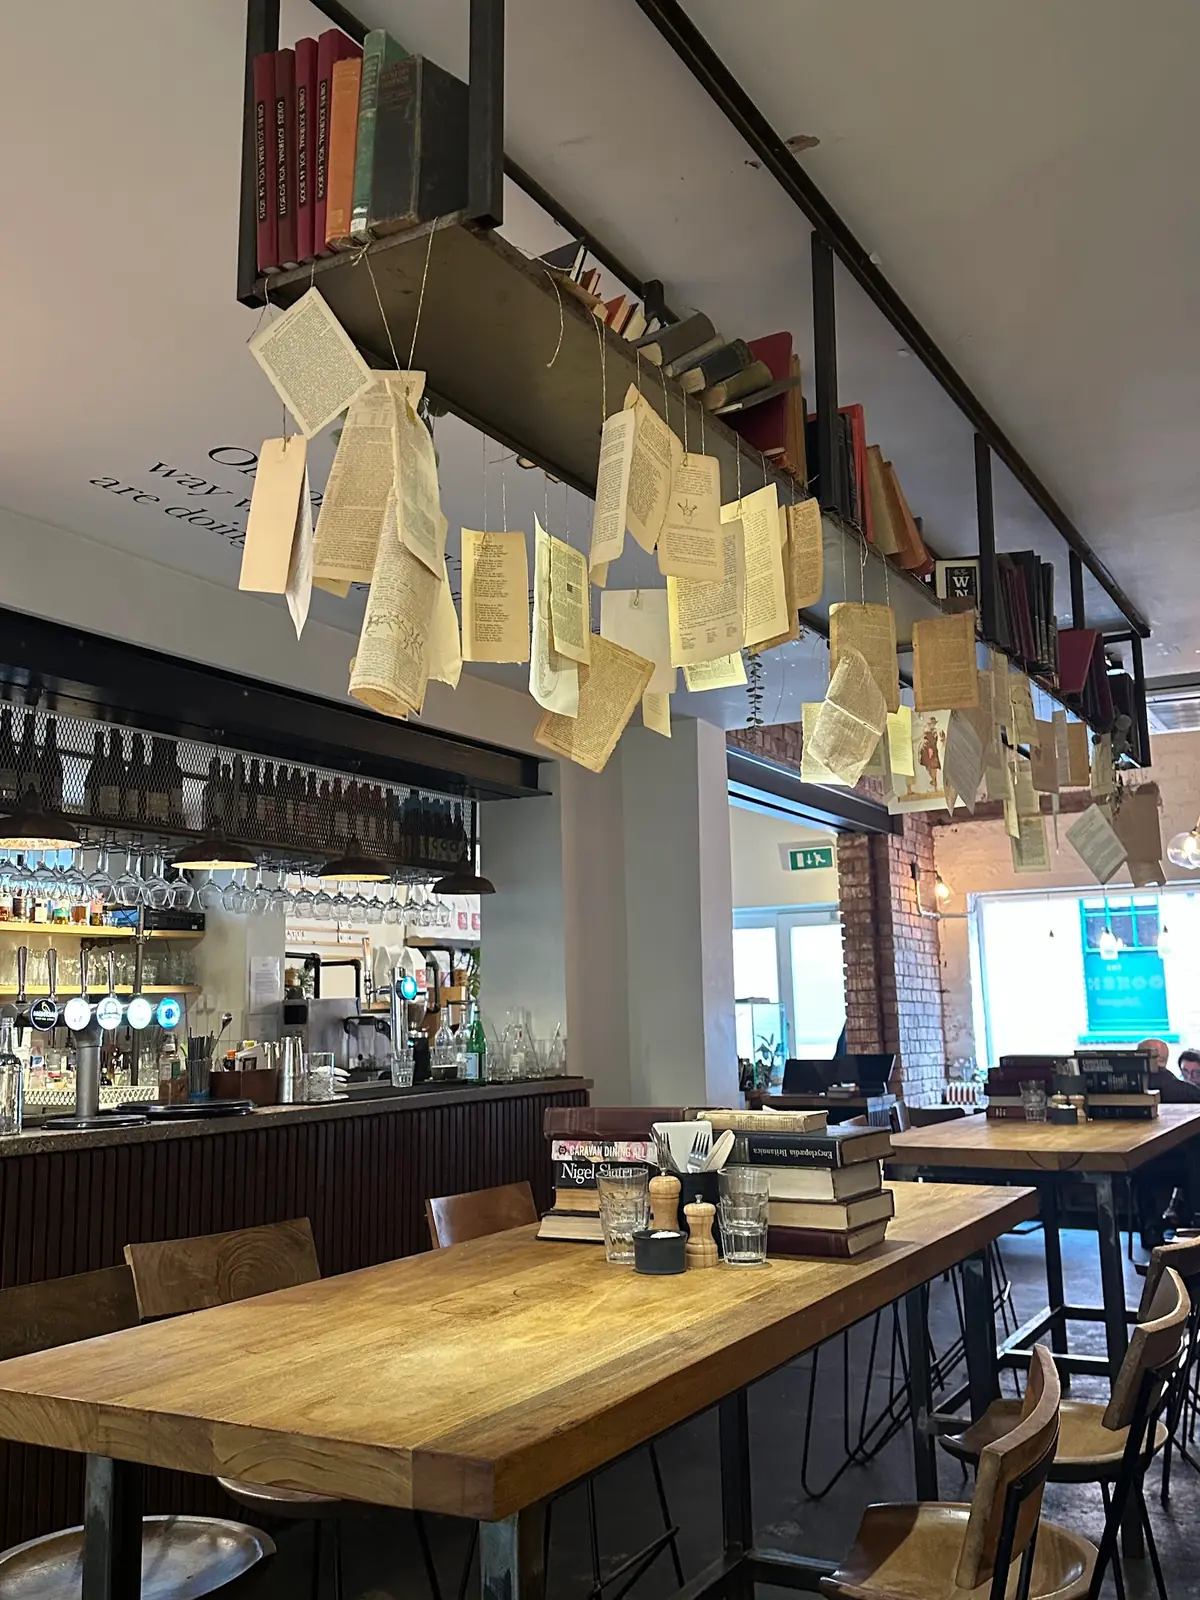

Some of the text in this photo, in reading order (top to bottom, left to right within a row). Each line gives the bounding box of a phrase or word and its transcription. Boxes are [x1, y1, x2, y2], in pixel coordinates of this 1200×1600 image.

[318, 108, 326, 145] JOURNAL
[257, 130, 265, 167] JOURNAL
[277, 127, 285, 164] JOURNAL
[278, 166, 286, 183] VOL
[89, 475, 160, 505] are
[148, 461, 234, 496] way
[952, 576, 970, 588] W
[568, 1145, 603, 1157] CARAVAN
[604, 1146, 631, 1158] DINING
[632, 1147, 646, 1158] ALL
[752, 1147, 788, 1157] Britannica
[561, 1162, 595, 1184] Nigel
